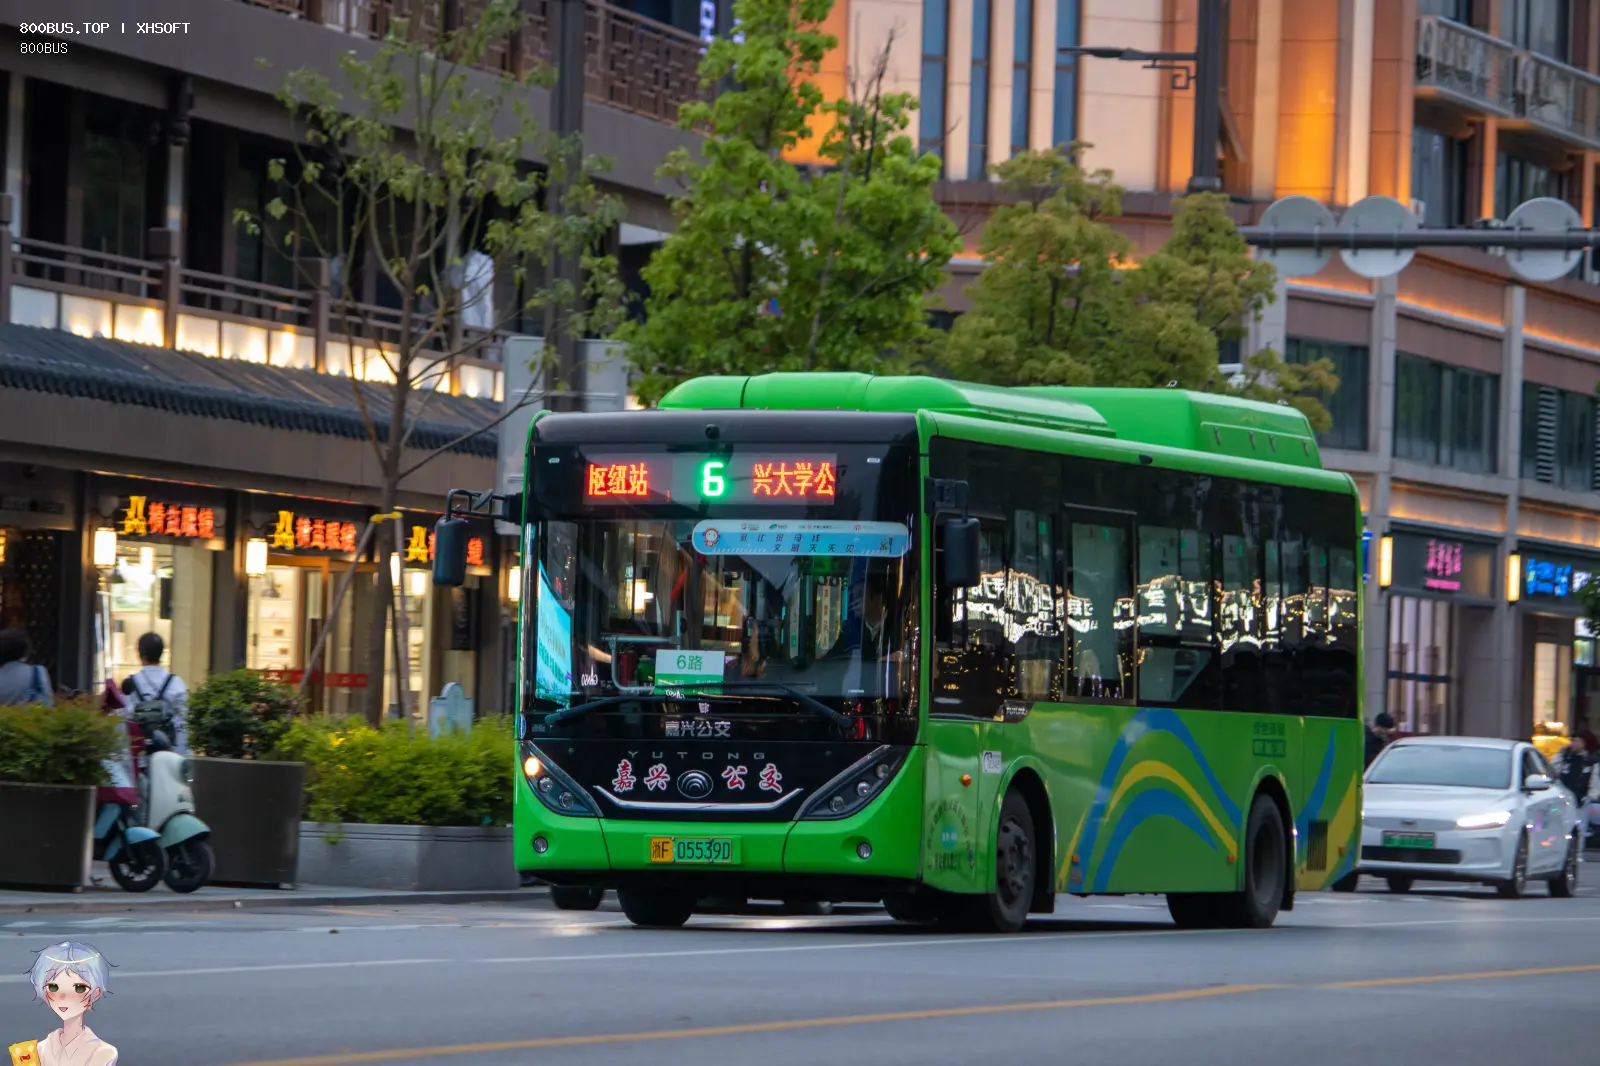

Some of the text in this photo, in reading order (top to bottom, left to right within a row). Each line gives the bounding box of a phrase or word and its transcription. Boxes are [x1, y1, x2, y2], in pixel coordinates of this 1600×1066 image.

[588, 461, 836, 497] 枢纽站 6 兴大学公
[676, 655, 703, 671] 6路
[665, 721, 731, 737] 嘉兴公交
[628, 751, 765, 760] YUTONG
[612, 759, 783, 794] 嘉兴 公交
[677, 841, 731, 859] 05539D
